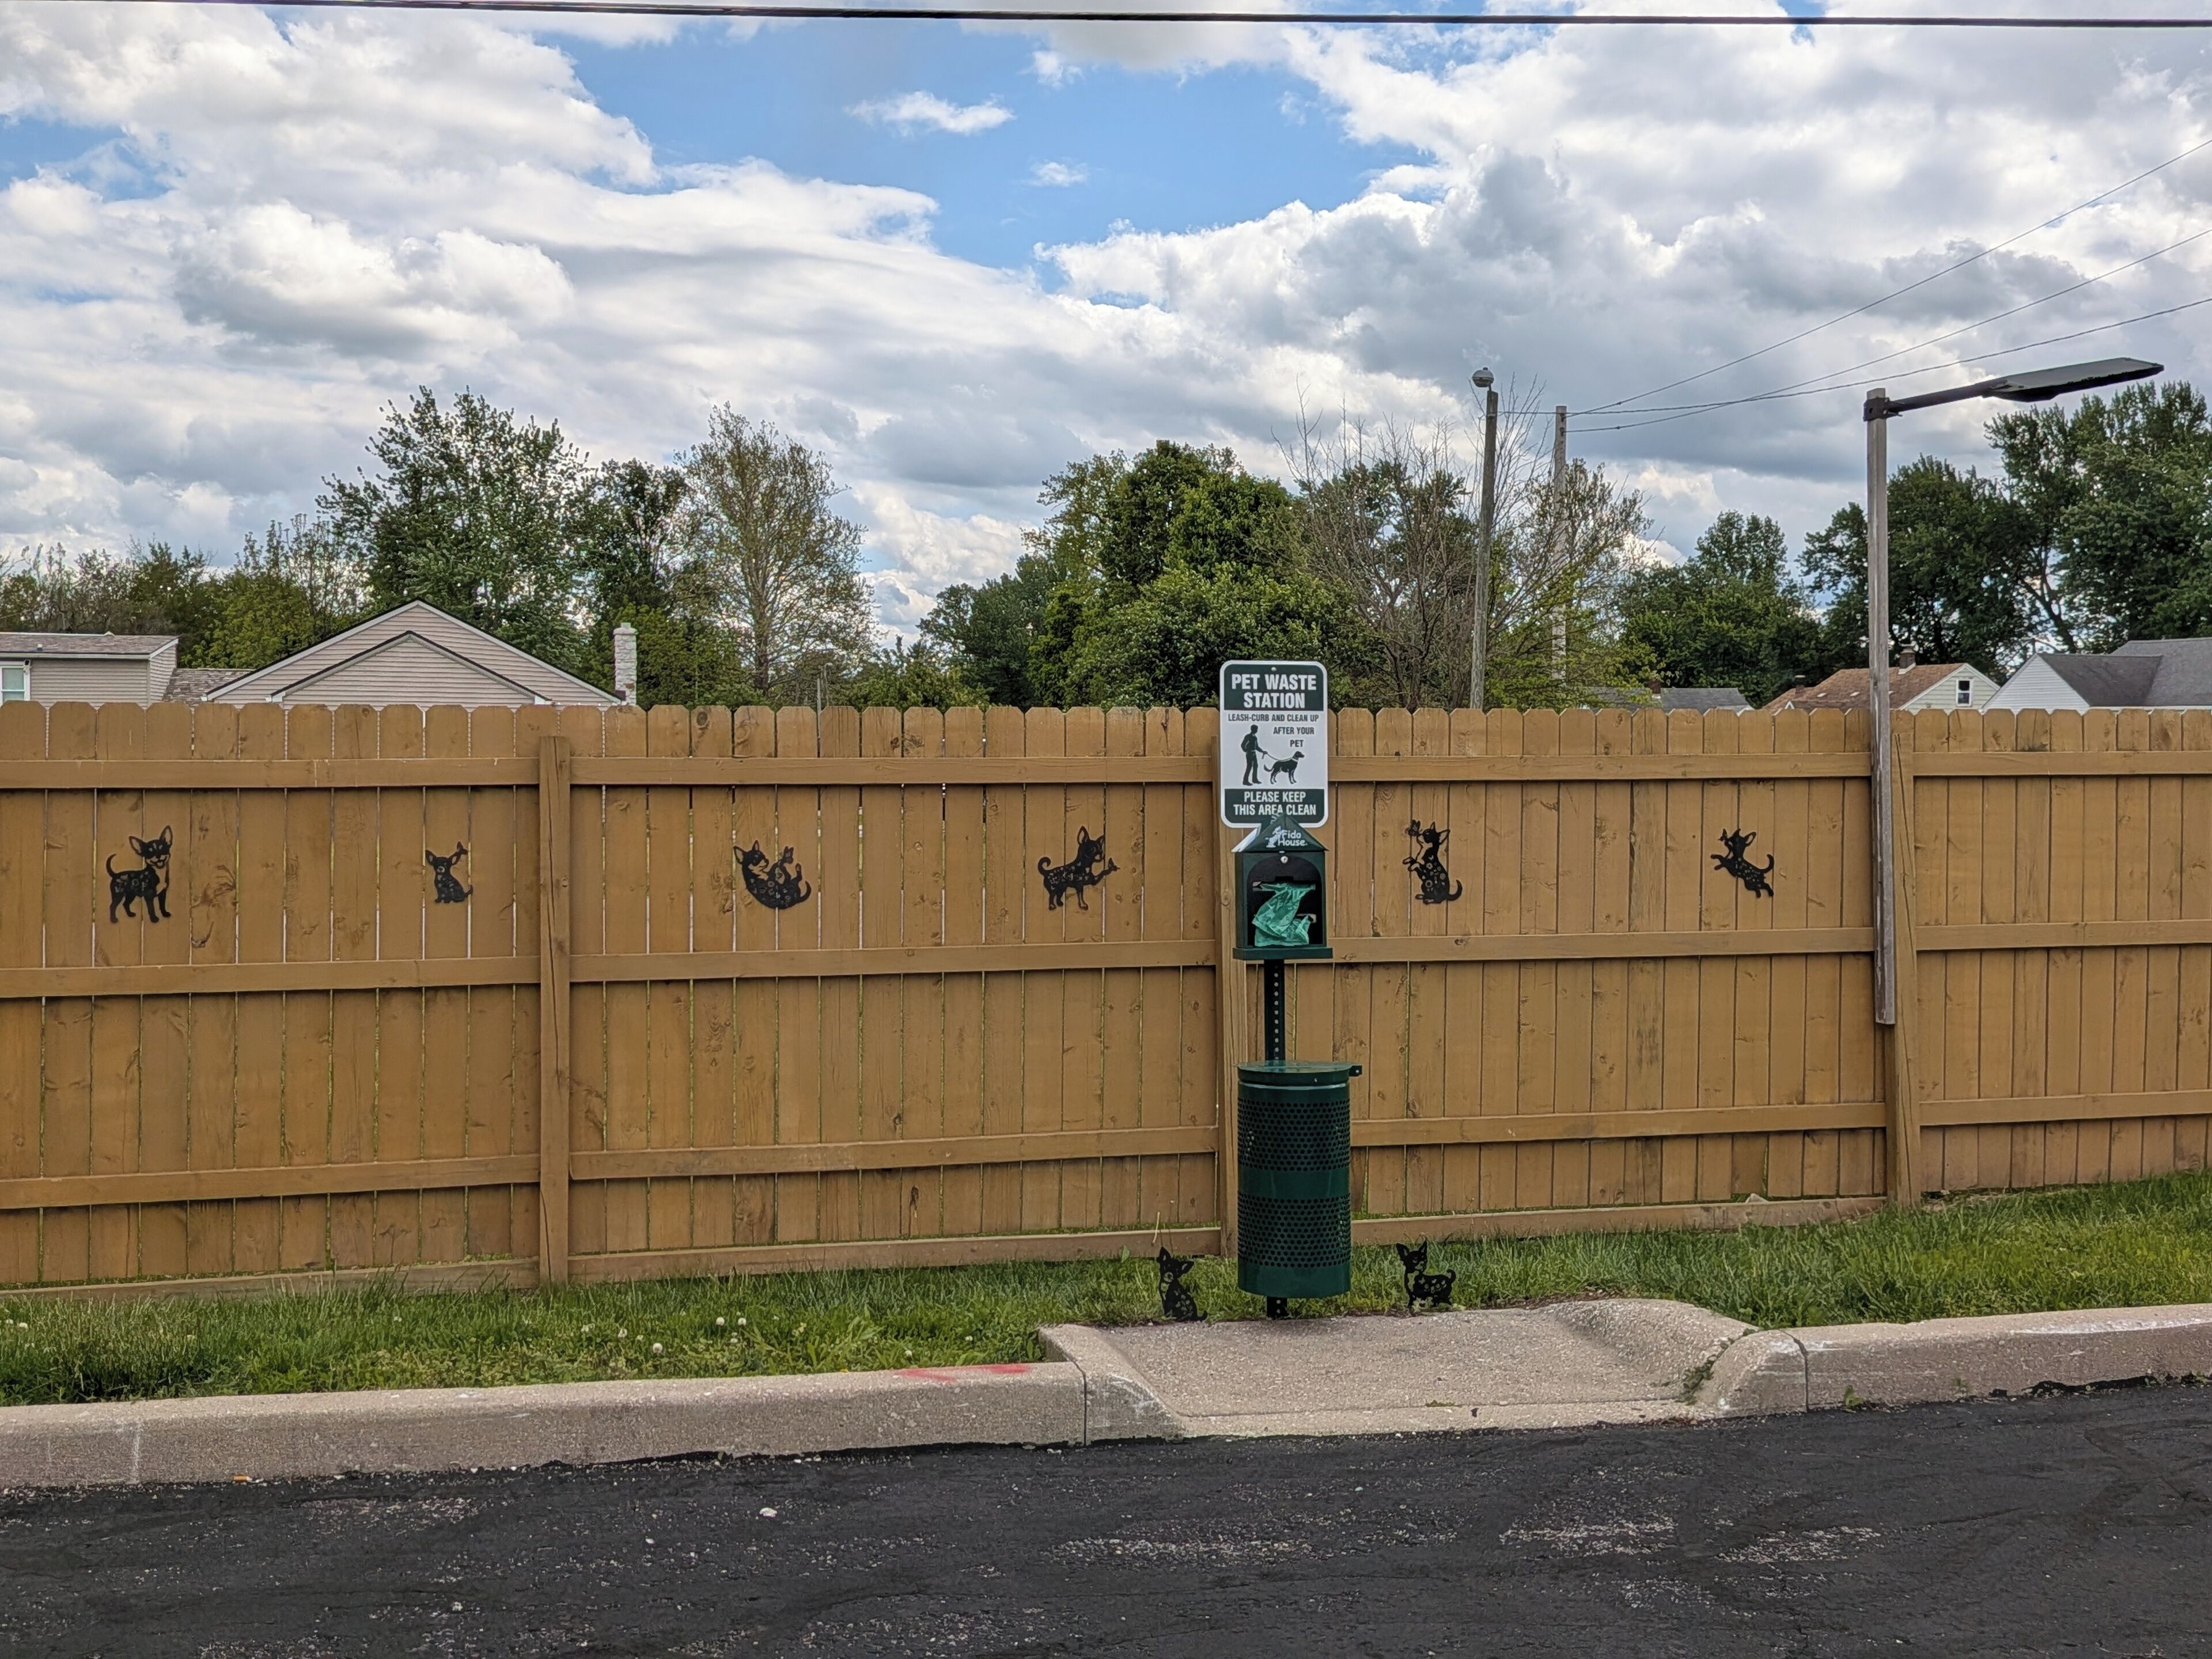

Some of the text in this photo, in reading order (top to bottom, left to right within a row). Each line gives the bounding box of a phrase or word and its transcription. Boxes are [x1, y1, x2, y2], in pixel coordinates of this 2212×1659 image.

[1232, 674, 1316, 690] PET WASTE
[1243, 692, 1305, 709] STATION
[1228, 714, 1269, 722] LEASH-CURB
[1244, 791, 1306, 802] PLEASE KEEP
[1233, 804, 1316, 815] THIS AREA CLEAN
[1282, 830, 1301, 839] Fido
